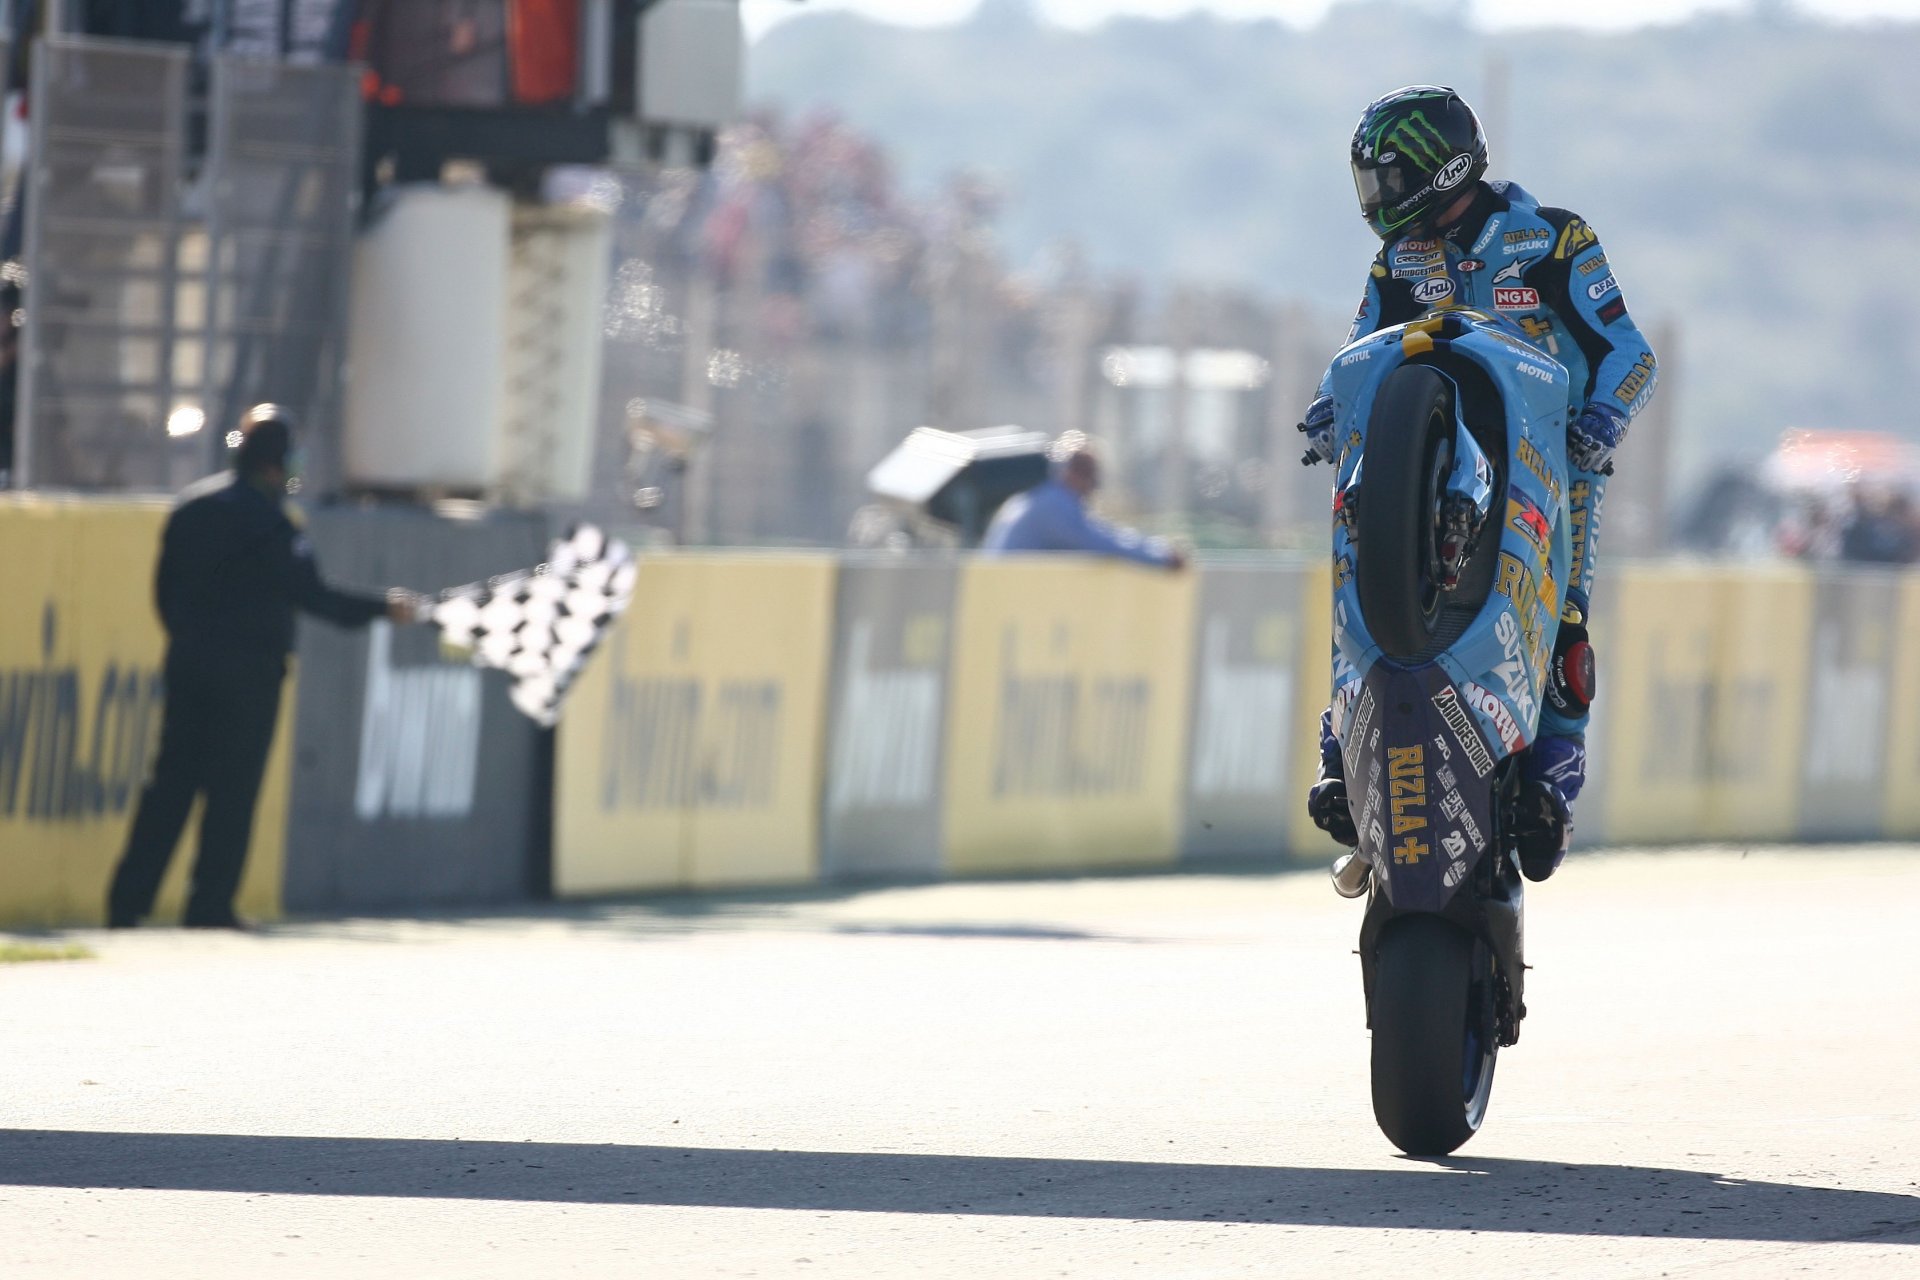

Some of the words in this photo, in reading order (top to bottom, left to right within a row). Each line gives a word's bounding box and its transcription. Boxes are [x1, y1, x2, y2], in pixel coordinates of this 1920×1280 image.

[1441, 154, 1468, 186] Arai
[1396, 240, 1437, 252] MOTUL
[1473, 219, 1500, 255] SUZUKI
[1503, 240, 1548, 254] SUZUKI
[1394, 263, 1446, 278] BRIDGESTONE
[1414, 280, 1450, 299] Arai
[1497, 290, 1536, 303] NGK
[1341, 350, 1371, 367] MOTUL
[1516, 361, 1553, 384] MOTUL
[1494, 611, 1537, 731] SUZUKI
[1463, 681, 1520, 753] MOTUL
[1432, 685, 1494, 778] BRIDGESTONE
[1388, 744, 1429, 864] RIZLA+
